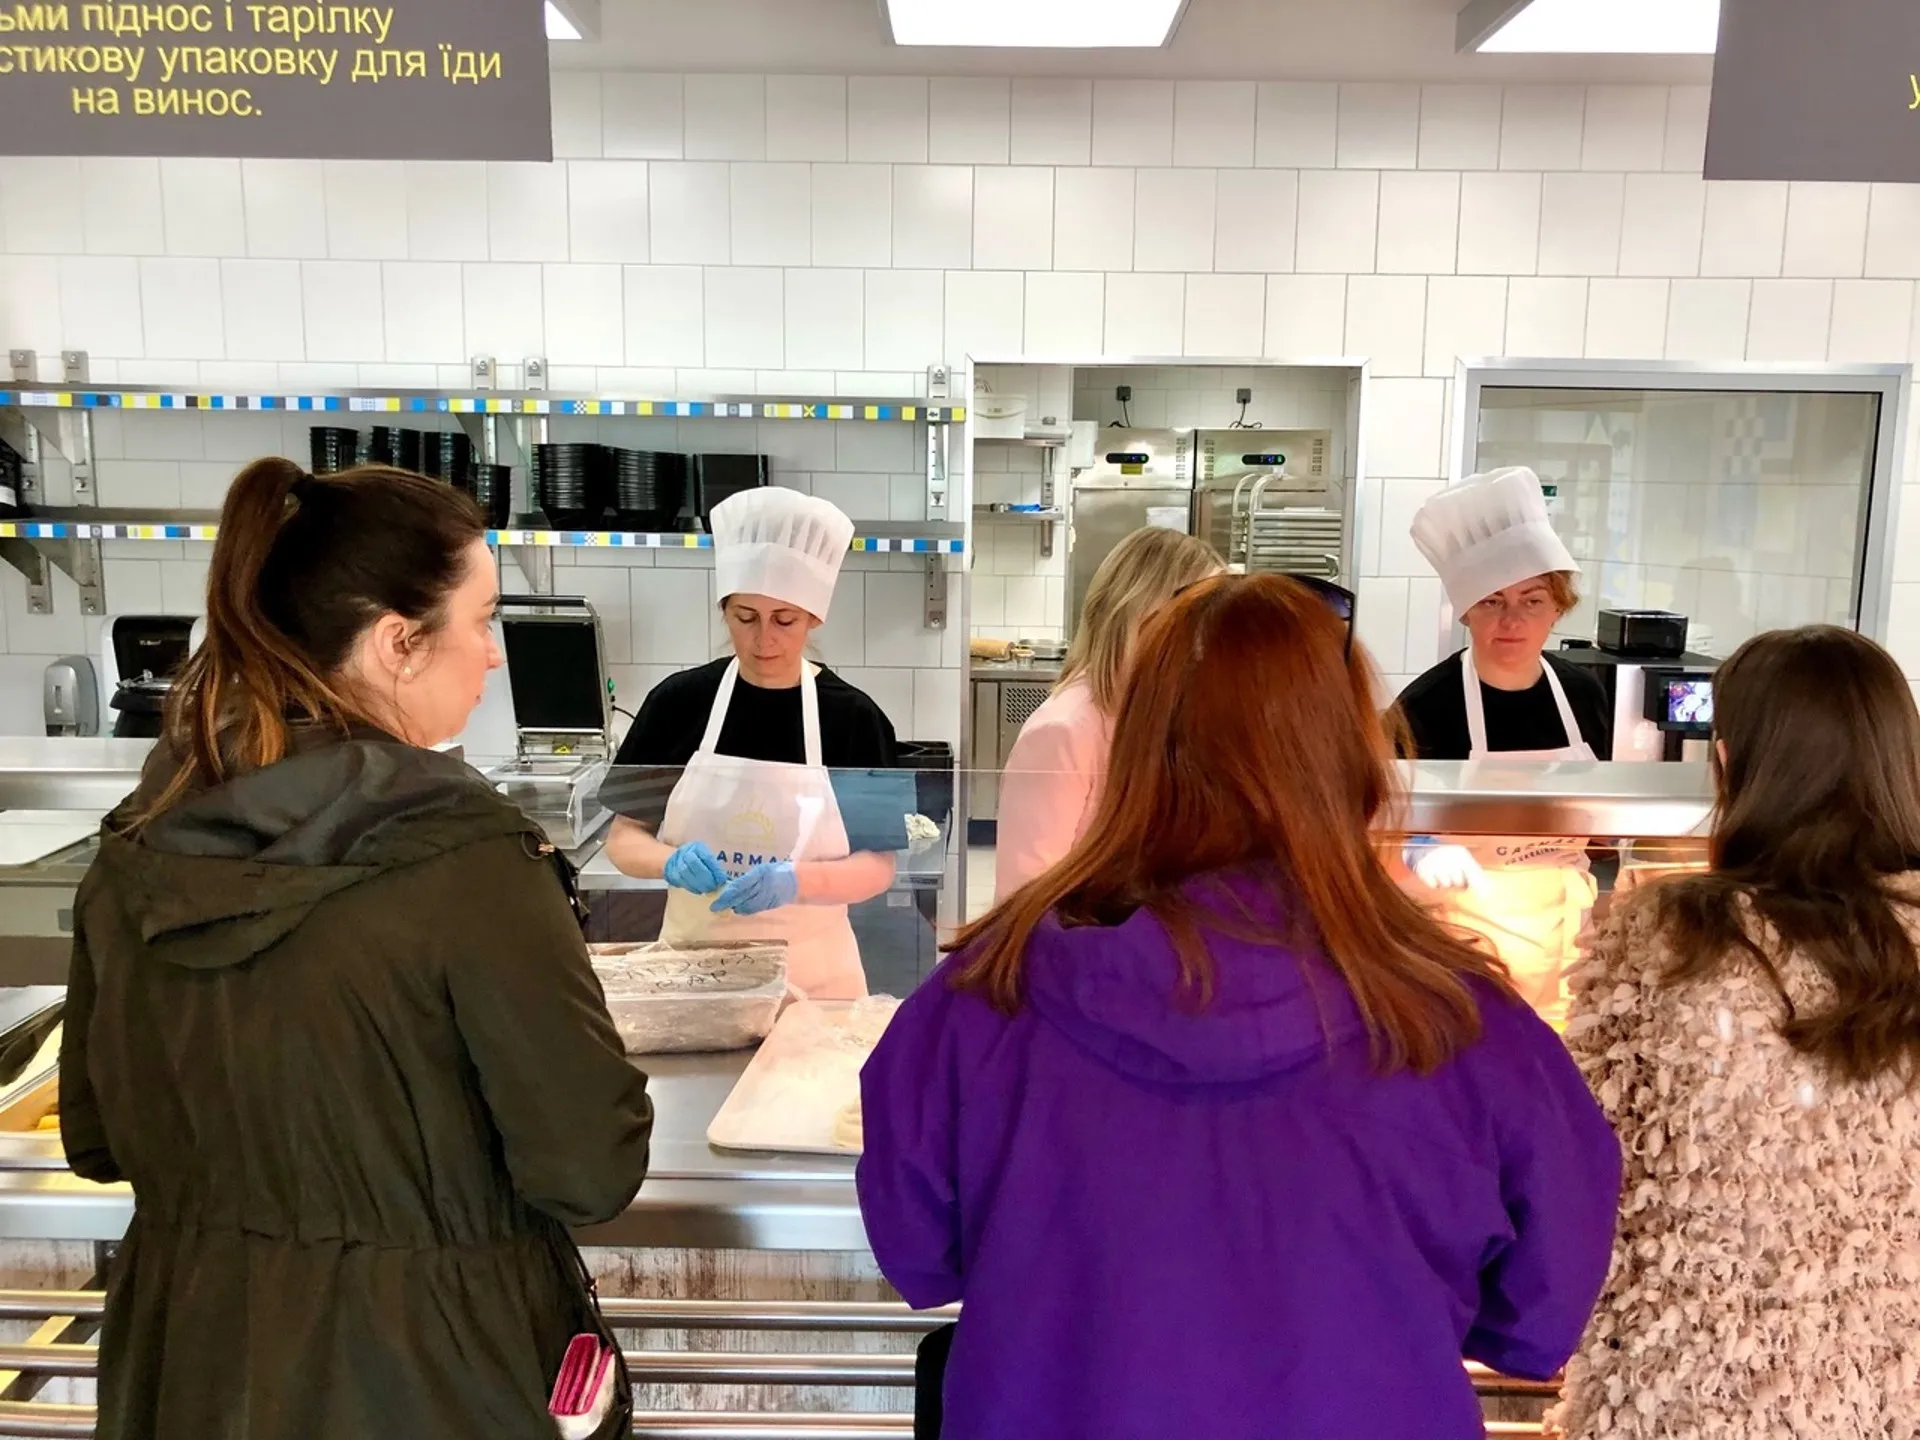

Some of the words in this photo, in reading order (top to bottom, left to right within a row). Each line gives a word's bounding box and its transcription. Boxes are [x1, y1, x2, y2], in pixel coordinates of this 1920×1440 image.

[82, 0, 212, 37] піднос
[247, 0, 393, 43] тарілку
[0, 46, 145, 82] стикову
[158, 47, 338, 84] упаковку
[351, 49, 427, 81] для
[438, 44, 501, 84] їди
[72, 87, 120, 115] на
[133, 88, 262, 116] винос.
